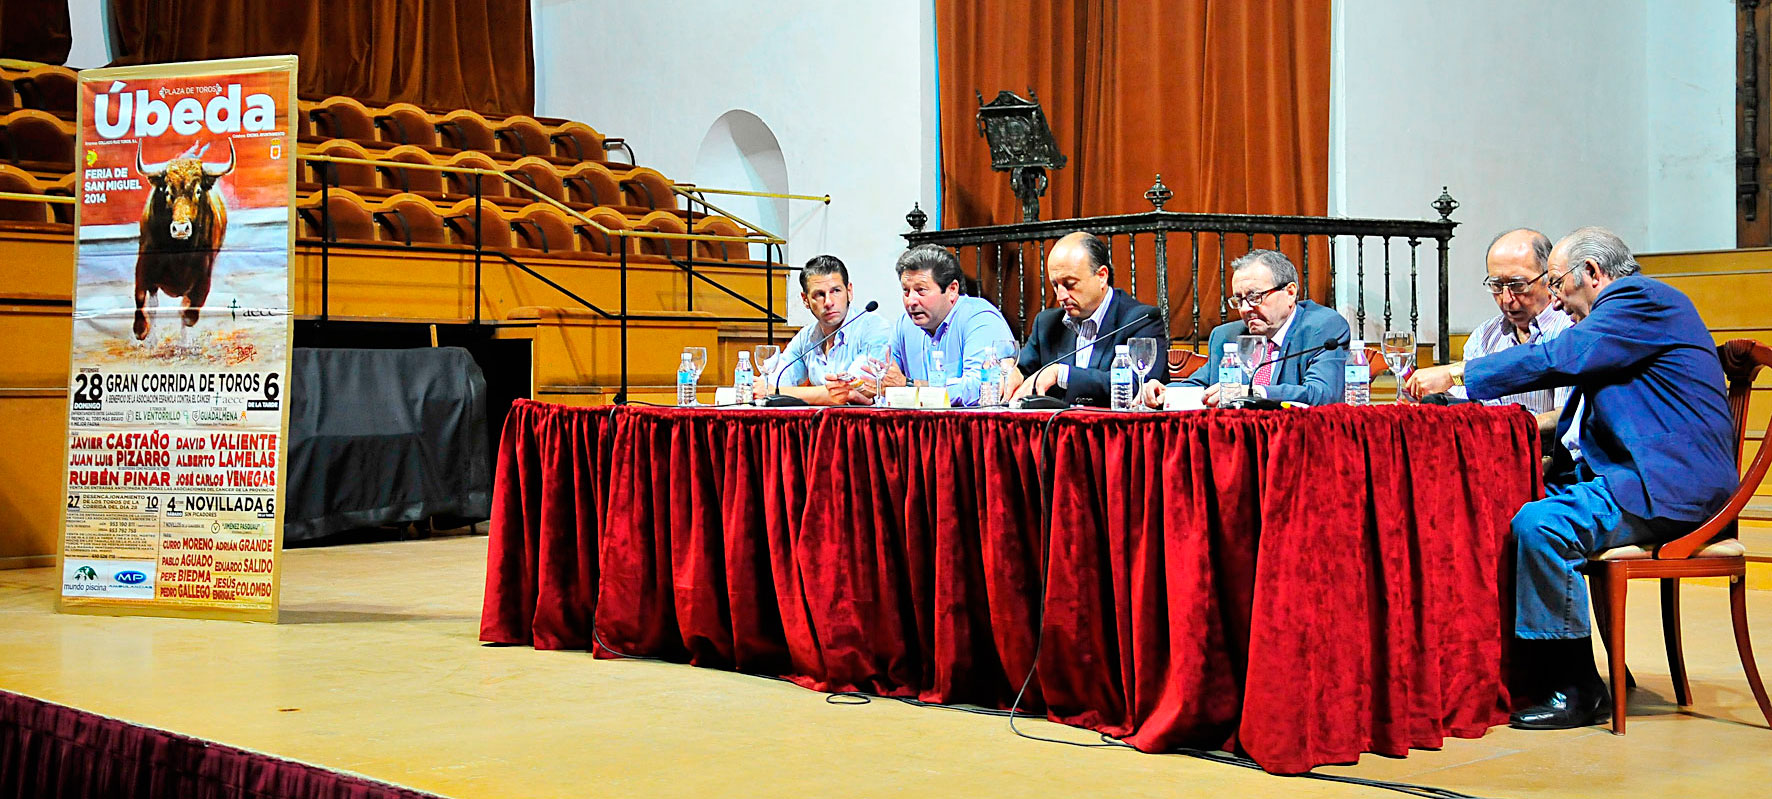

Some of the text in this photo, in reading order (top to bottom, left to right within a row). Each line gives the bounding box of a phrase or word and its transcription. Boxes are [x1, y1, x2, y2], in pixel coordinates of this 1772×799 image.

[165, 87, 185, 95] PLAZA
[94, 80, 276, 139] Úbeda
[85, 167, 128, 179] FERIA DE
[84, 179, 142, 192] SAN MIGUEL
[84, 193, 106, 204] 2014
[74, 373, 103, 400] 28
[106, 373, 260, 392] GRAN CORRIDA DE TOROS
[264, 373, 279, 400] 6
[135, 411, 180, 420] EL VENTORRILLO
[200, 412, 237, 420] GUADALMENA
[71, 429, 169, 449] JAVIER CASTAÑO
[176, 433, 276, 450] DAVID VALIENTE
[70, 450, 170, 466] JUAN LUIS PIZARRO
[176, 451, 275, 468] ALBERTO LAMELAS
[70, 468, 170, 486] RUBÉN PINAR
[176, 470, 275, 487] JOSÉ CARLOS VENEGAS
[68, 495, 80, 508] 27
[147, 496, 158, 508] 10
[167, 496, 176, 511] 4
[186, 496, 263, 511] NOVILLADA
[266, 498, 274, 513] 6
[163, 540, 181, 549] CURRO
[183, 538, 213, 550] MORENO
[215, 539, 272, 552] ADRIÁN GRANDE
[162, 554, 213, 567] PABLO AGUADO
[215, 558, 272, 573] EDUARDO SALIDO
[118, 573, 143, 581] MP
[160, 570, 211, 582] PEPE BIEDMA
[213, 576, 236, 589] JESÚS
[85, 583, 106, 592] piscina
[160, 584, 210, 599] PEDRO GALLEGO
[236, 581, 271, 597] COLOMBO
[212, 590, 235, 600] ENRIQUE
